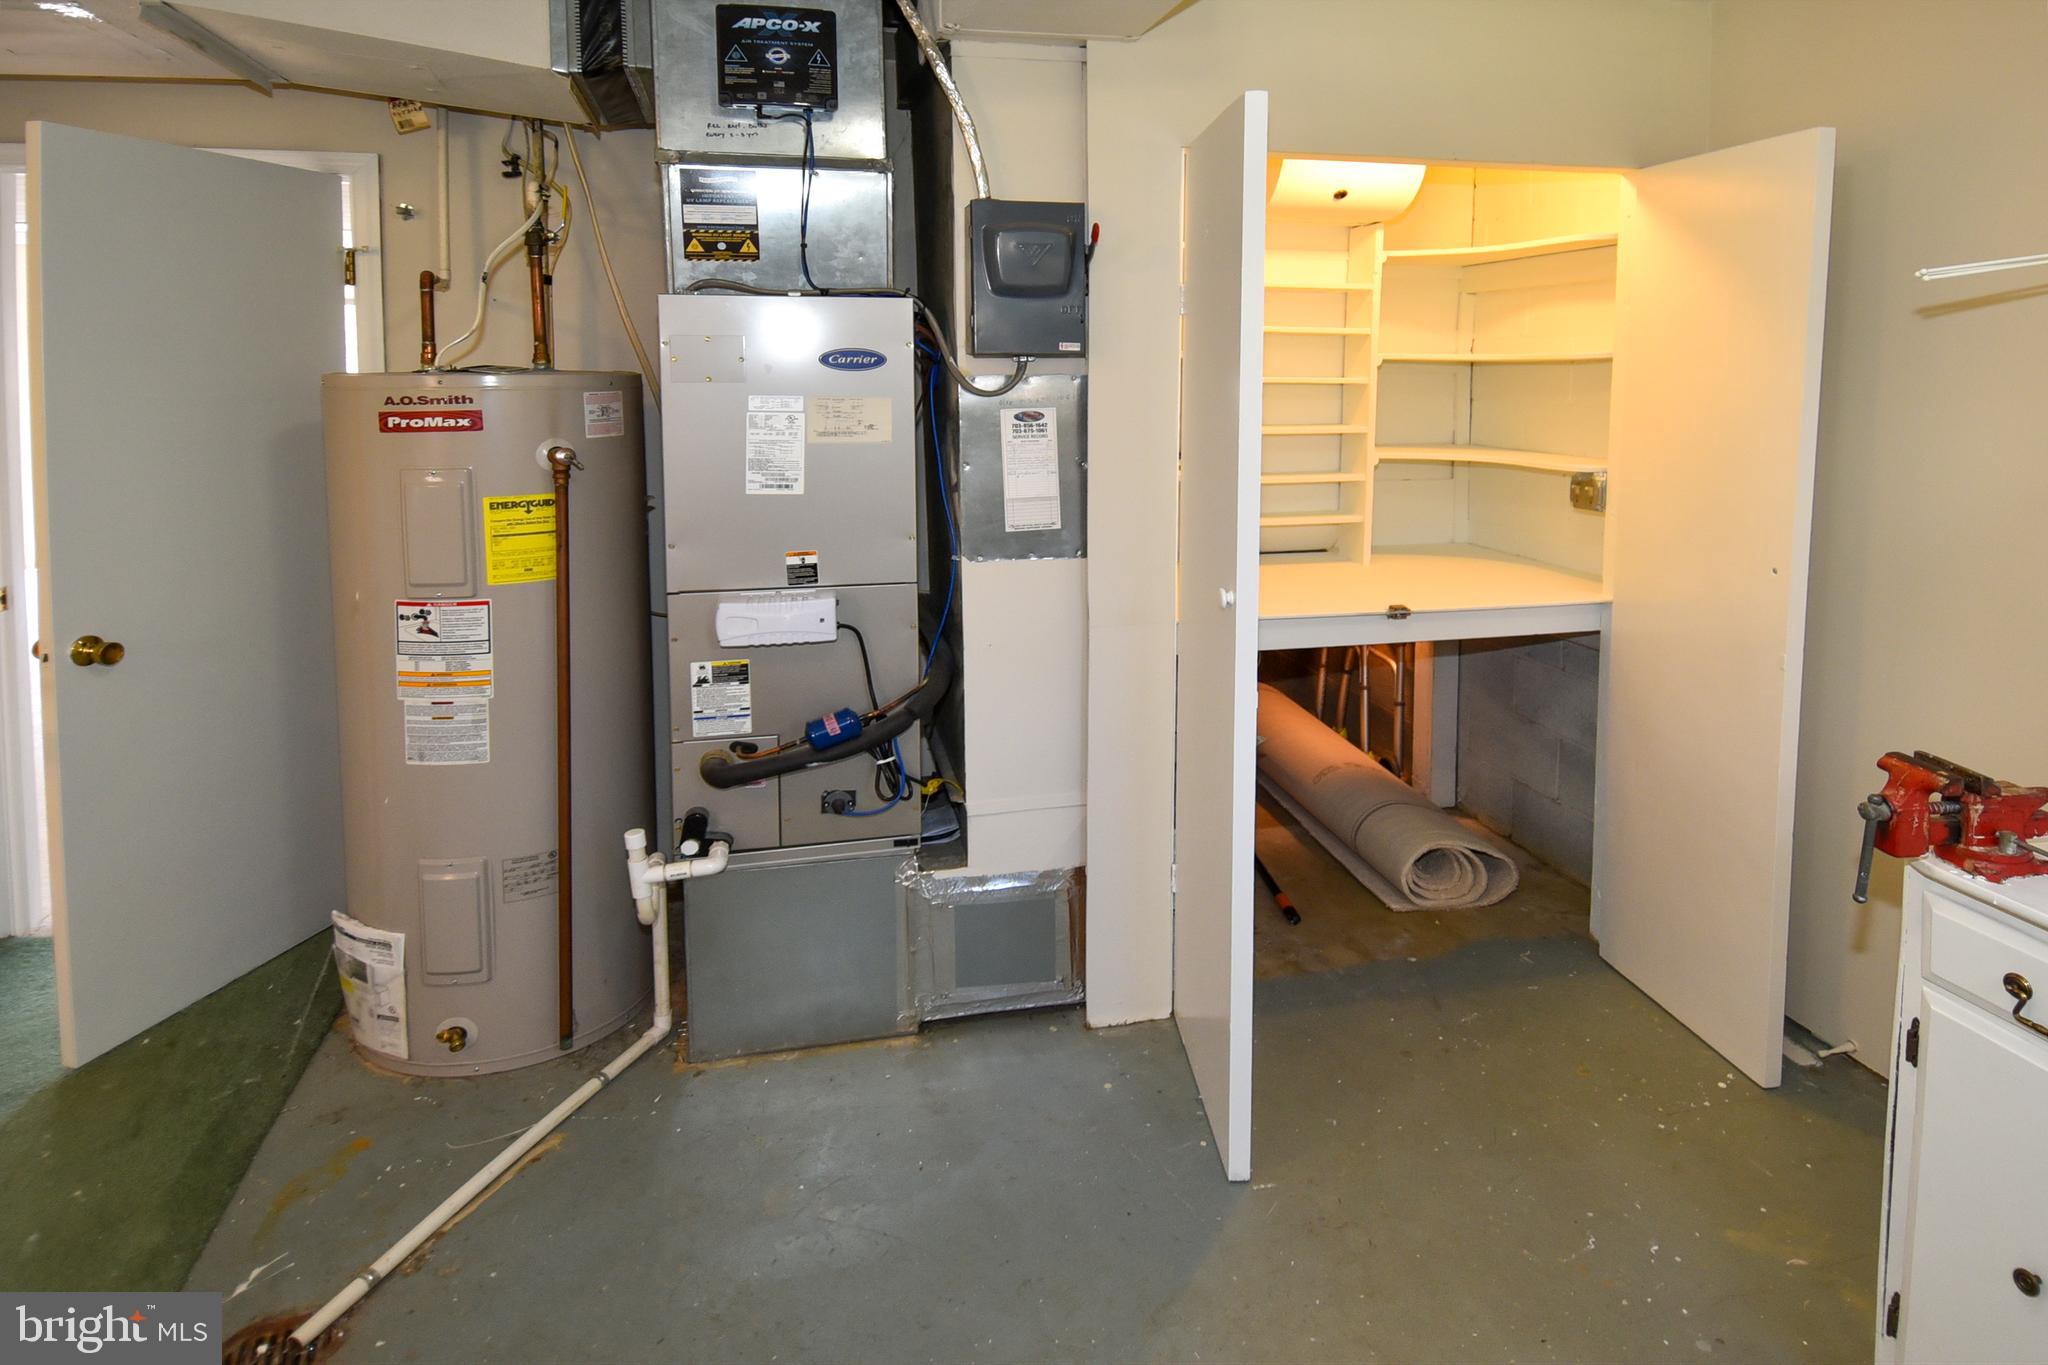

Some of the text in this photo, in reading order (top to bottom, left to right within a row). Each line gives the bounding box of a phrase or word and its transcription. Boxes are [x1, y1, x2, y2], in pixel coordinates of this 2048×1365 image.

[732, 17, 822, 33] APCO-X
[828, 353, 878, 365] Carrier
[387, 416, 472, 428] ProMax
[489, 498, 555, 513] ENERGYGUID
